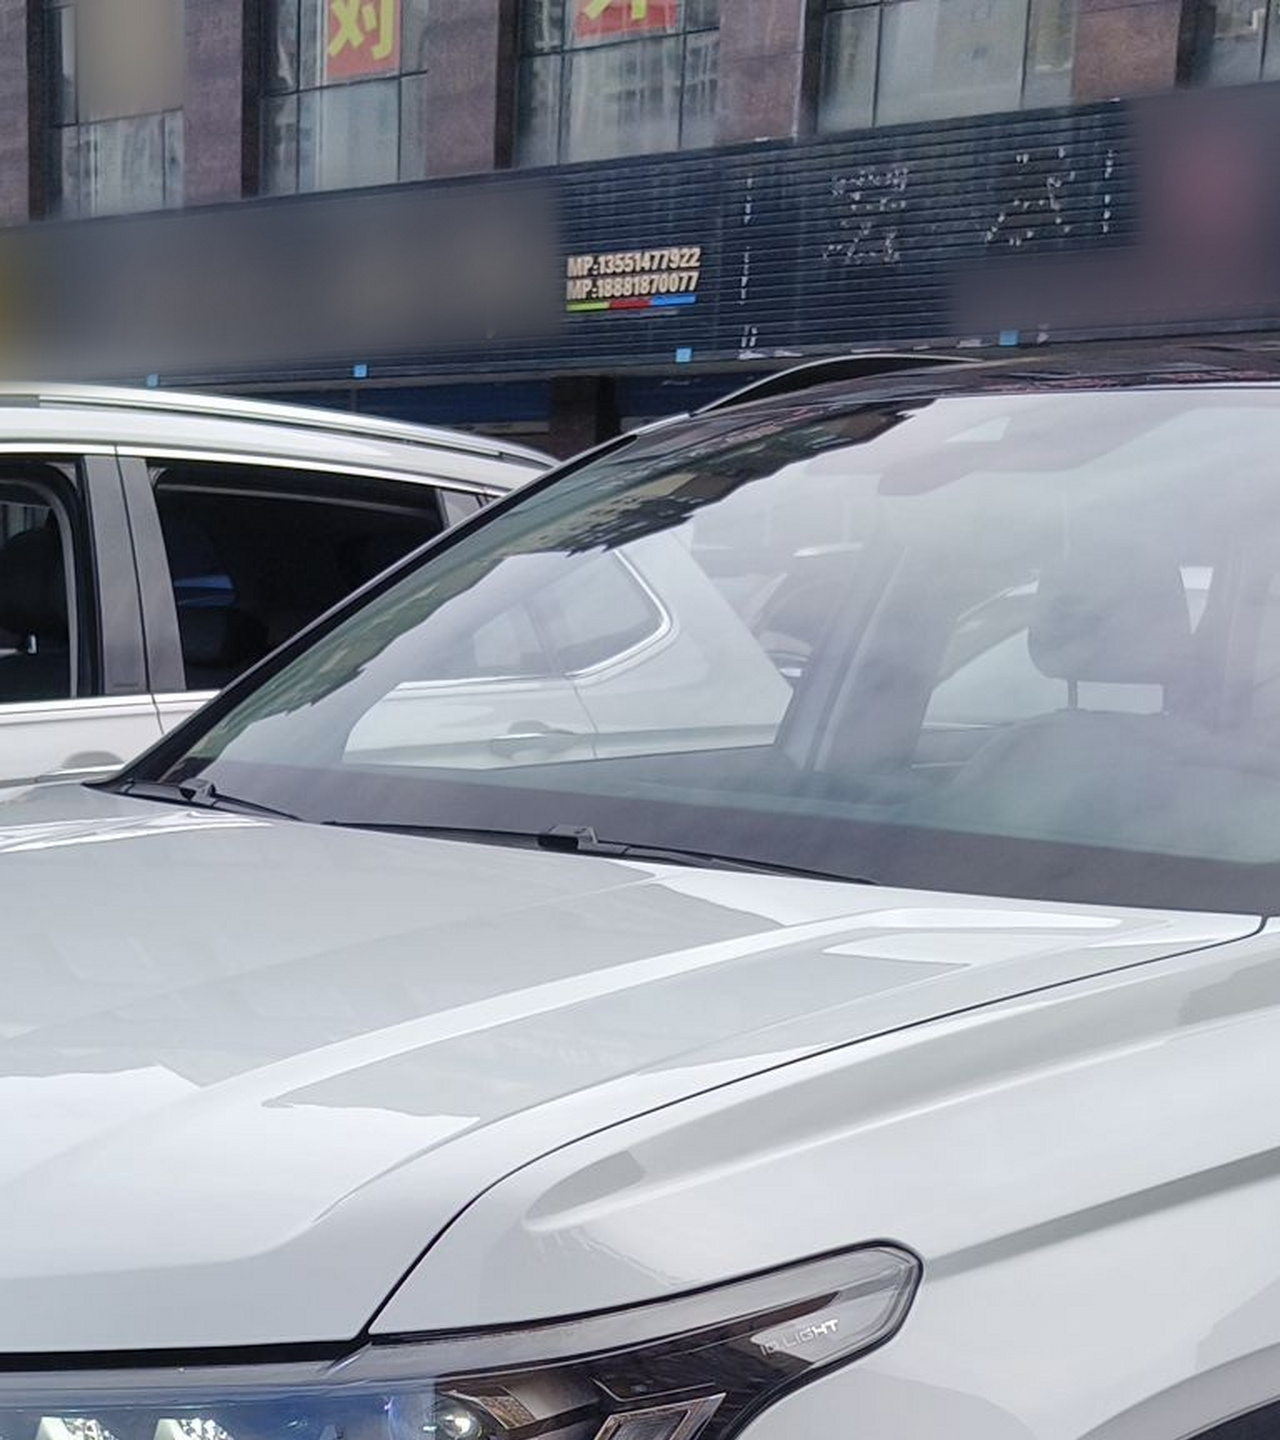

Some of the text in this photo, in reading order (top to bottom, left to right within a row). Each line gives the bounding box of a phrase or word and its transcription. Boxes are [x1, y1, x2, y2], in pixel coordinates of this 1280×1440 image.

[329, 0, 395, 60] 对
[567, 247, 701, 277] MP:13551477922
[566, 271, 699, 300] MP:18881870077
